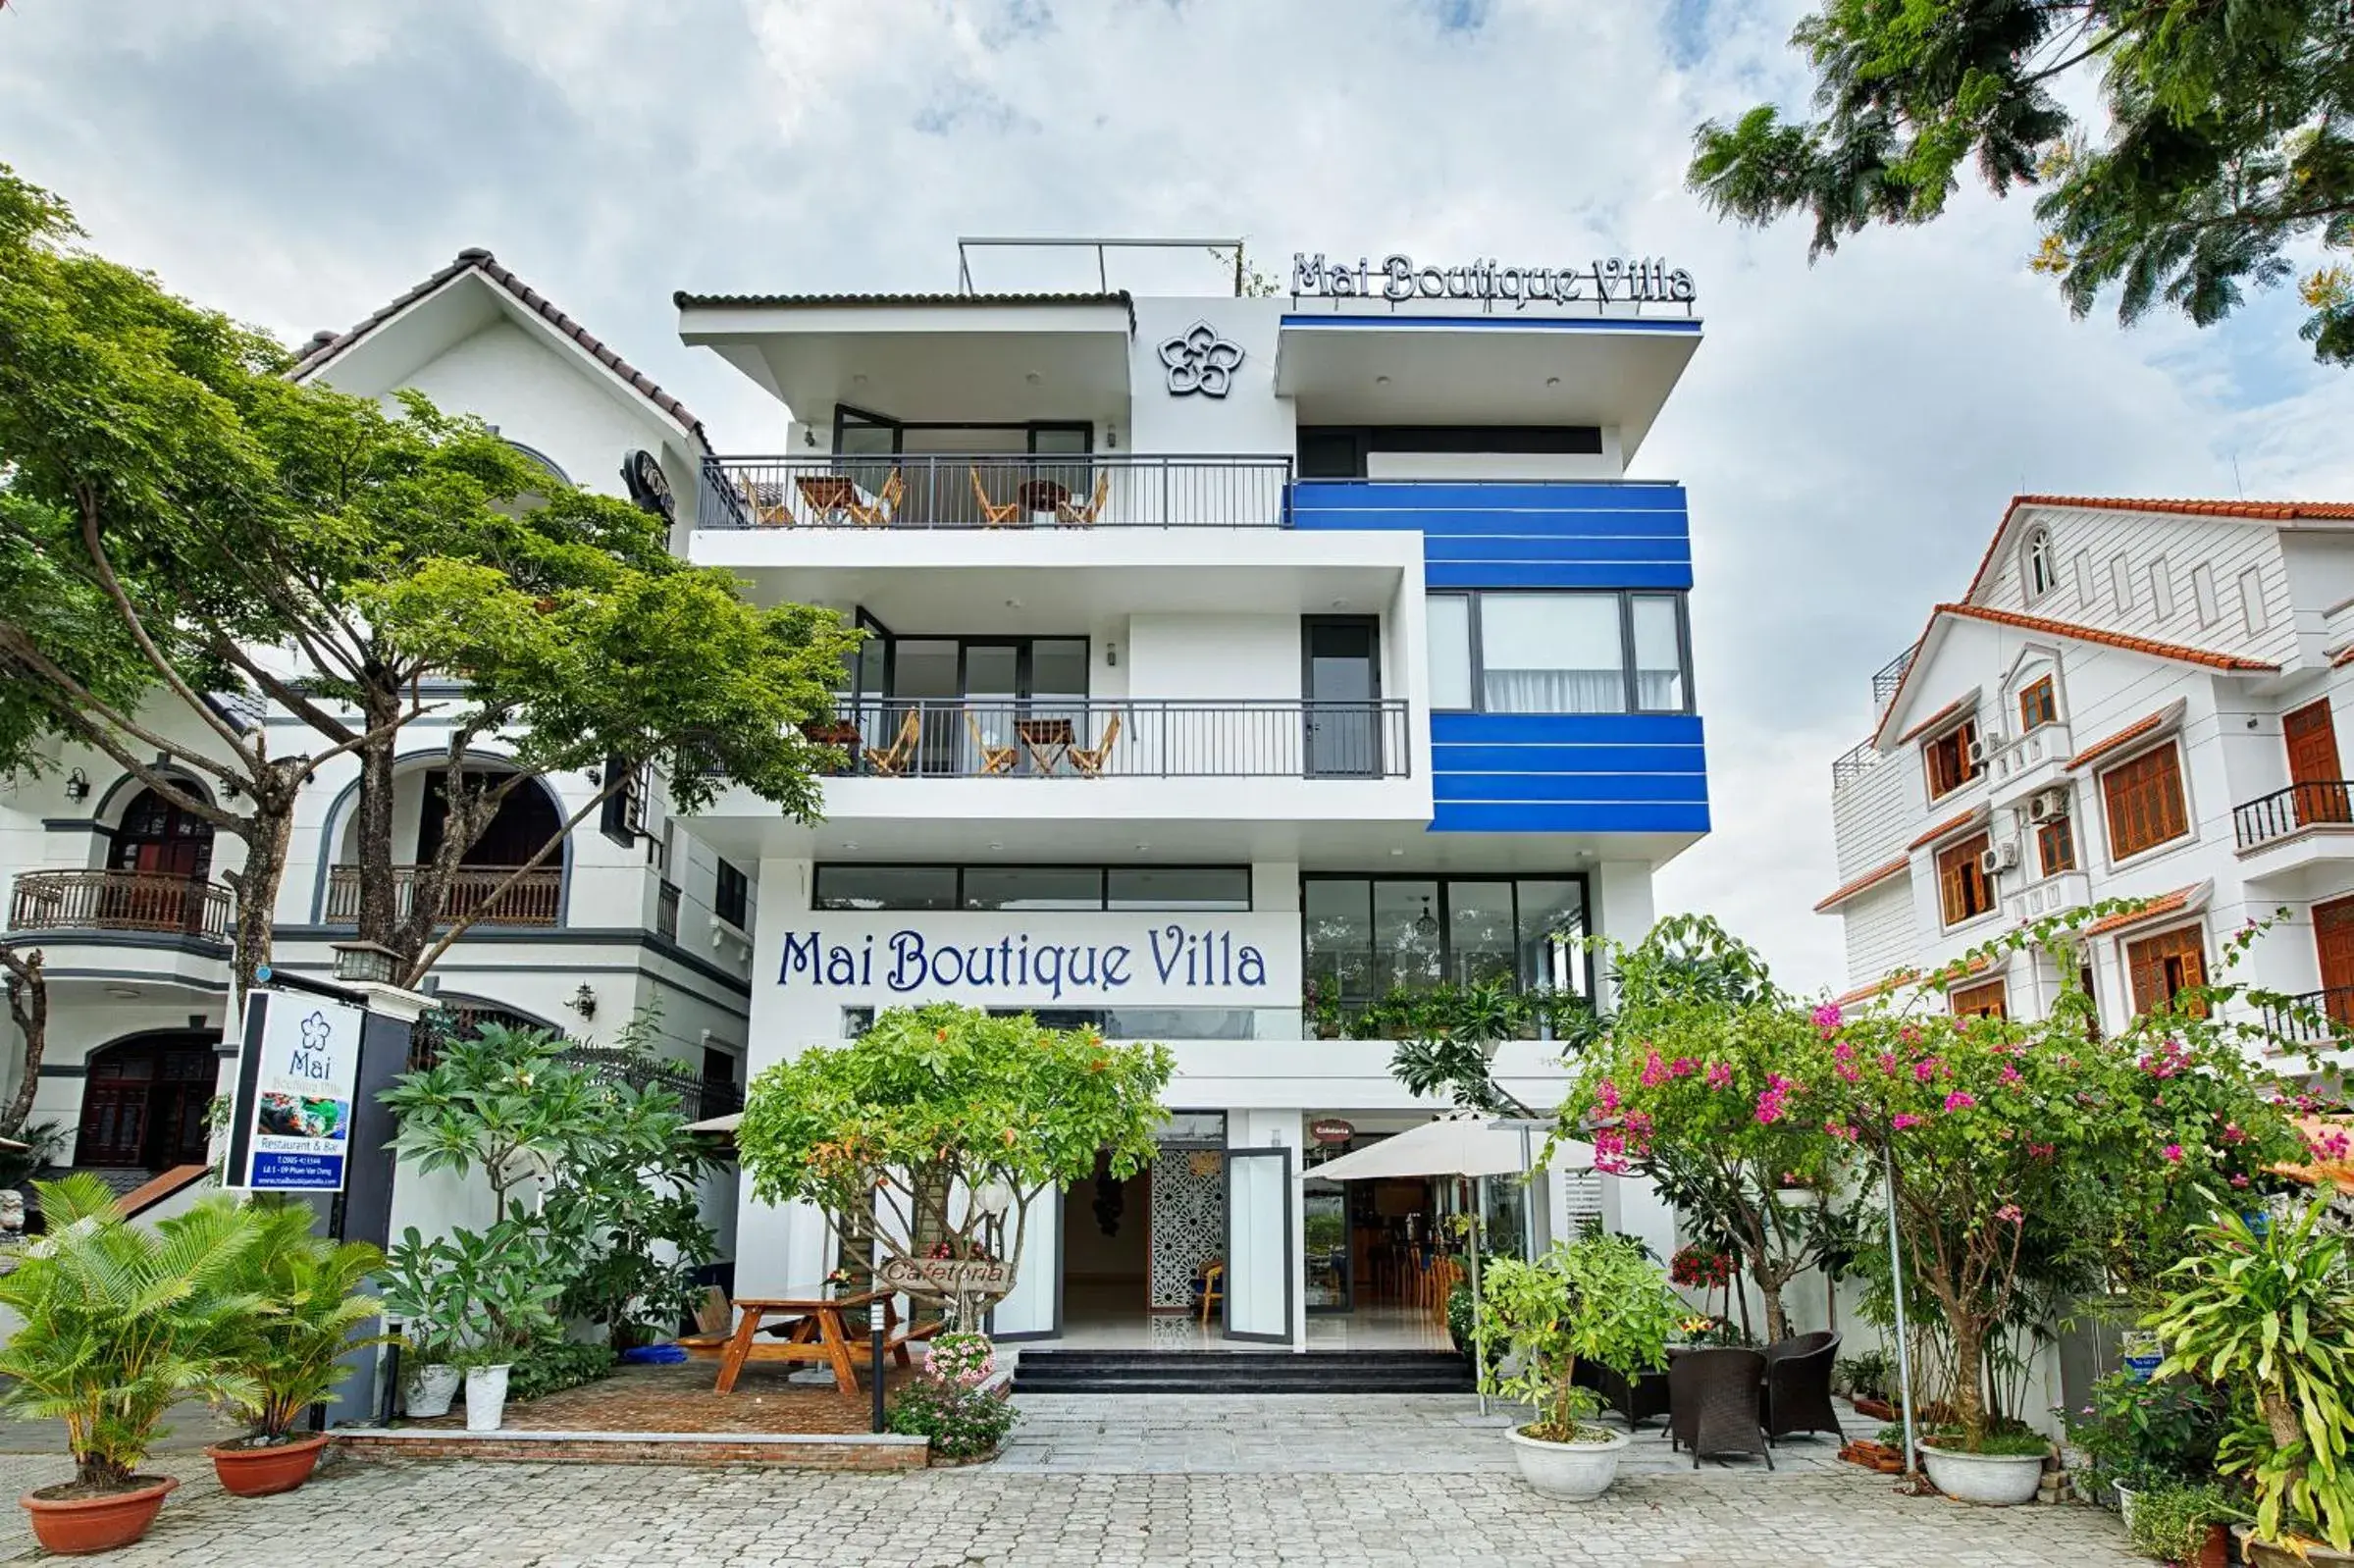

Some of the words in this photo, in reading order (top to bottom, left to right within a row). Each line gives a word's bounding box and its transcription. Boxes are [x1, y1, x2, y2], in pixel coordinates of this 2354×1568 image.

[1290, 252, 1369, 296] Mai
[1383, 253, 1582, 310] Boutique
[1593, 256, 1697, 303] Villa
[777, 931, 872, 985] Mai
[887, 930, 1131, 1001] Boutique
[1148, 924, 1267, 987] Villa
[288, 1050, 331, 1079] Mai
[261, 1138, 311, 1152] Restaurant
[313, 1141, 321, 1152] &
[324, 1141, 339, 1153] Bar
